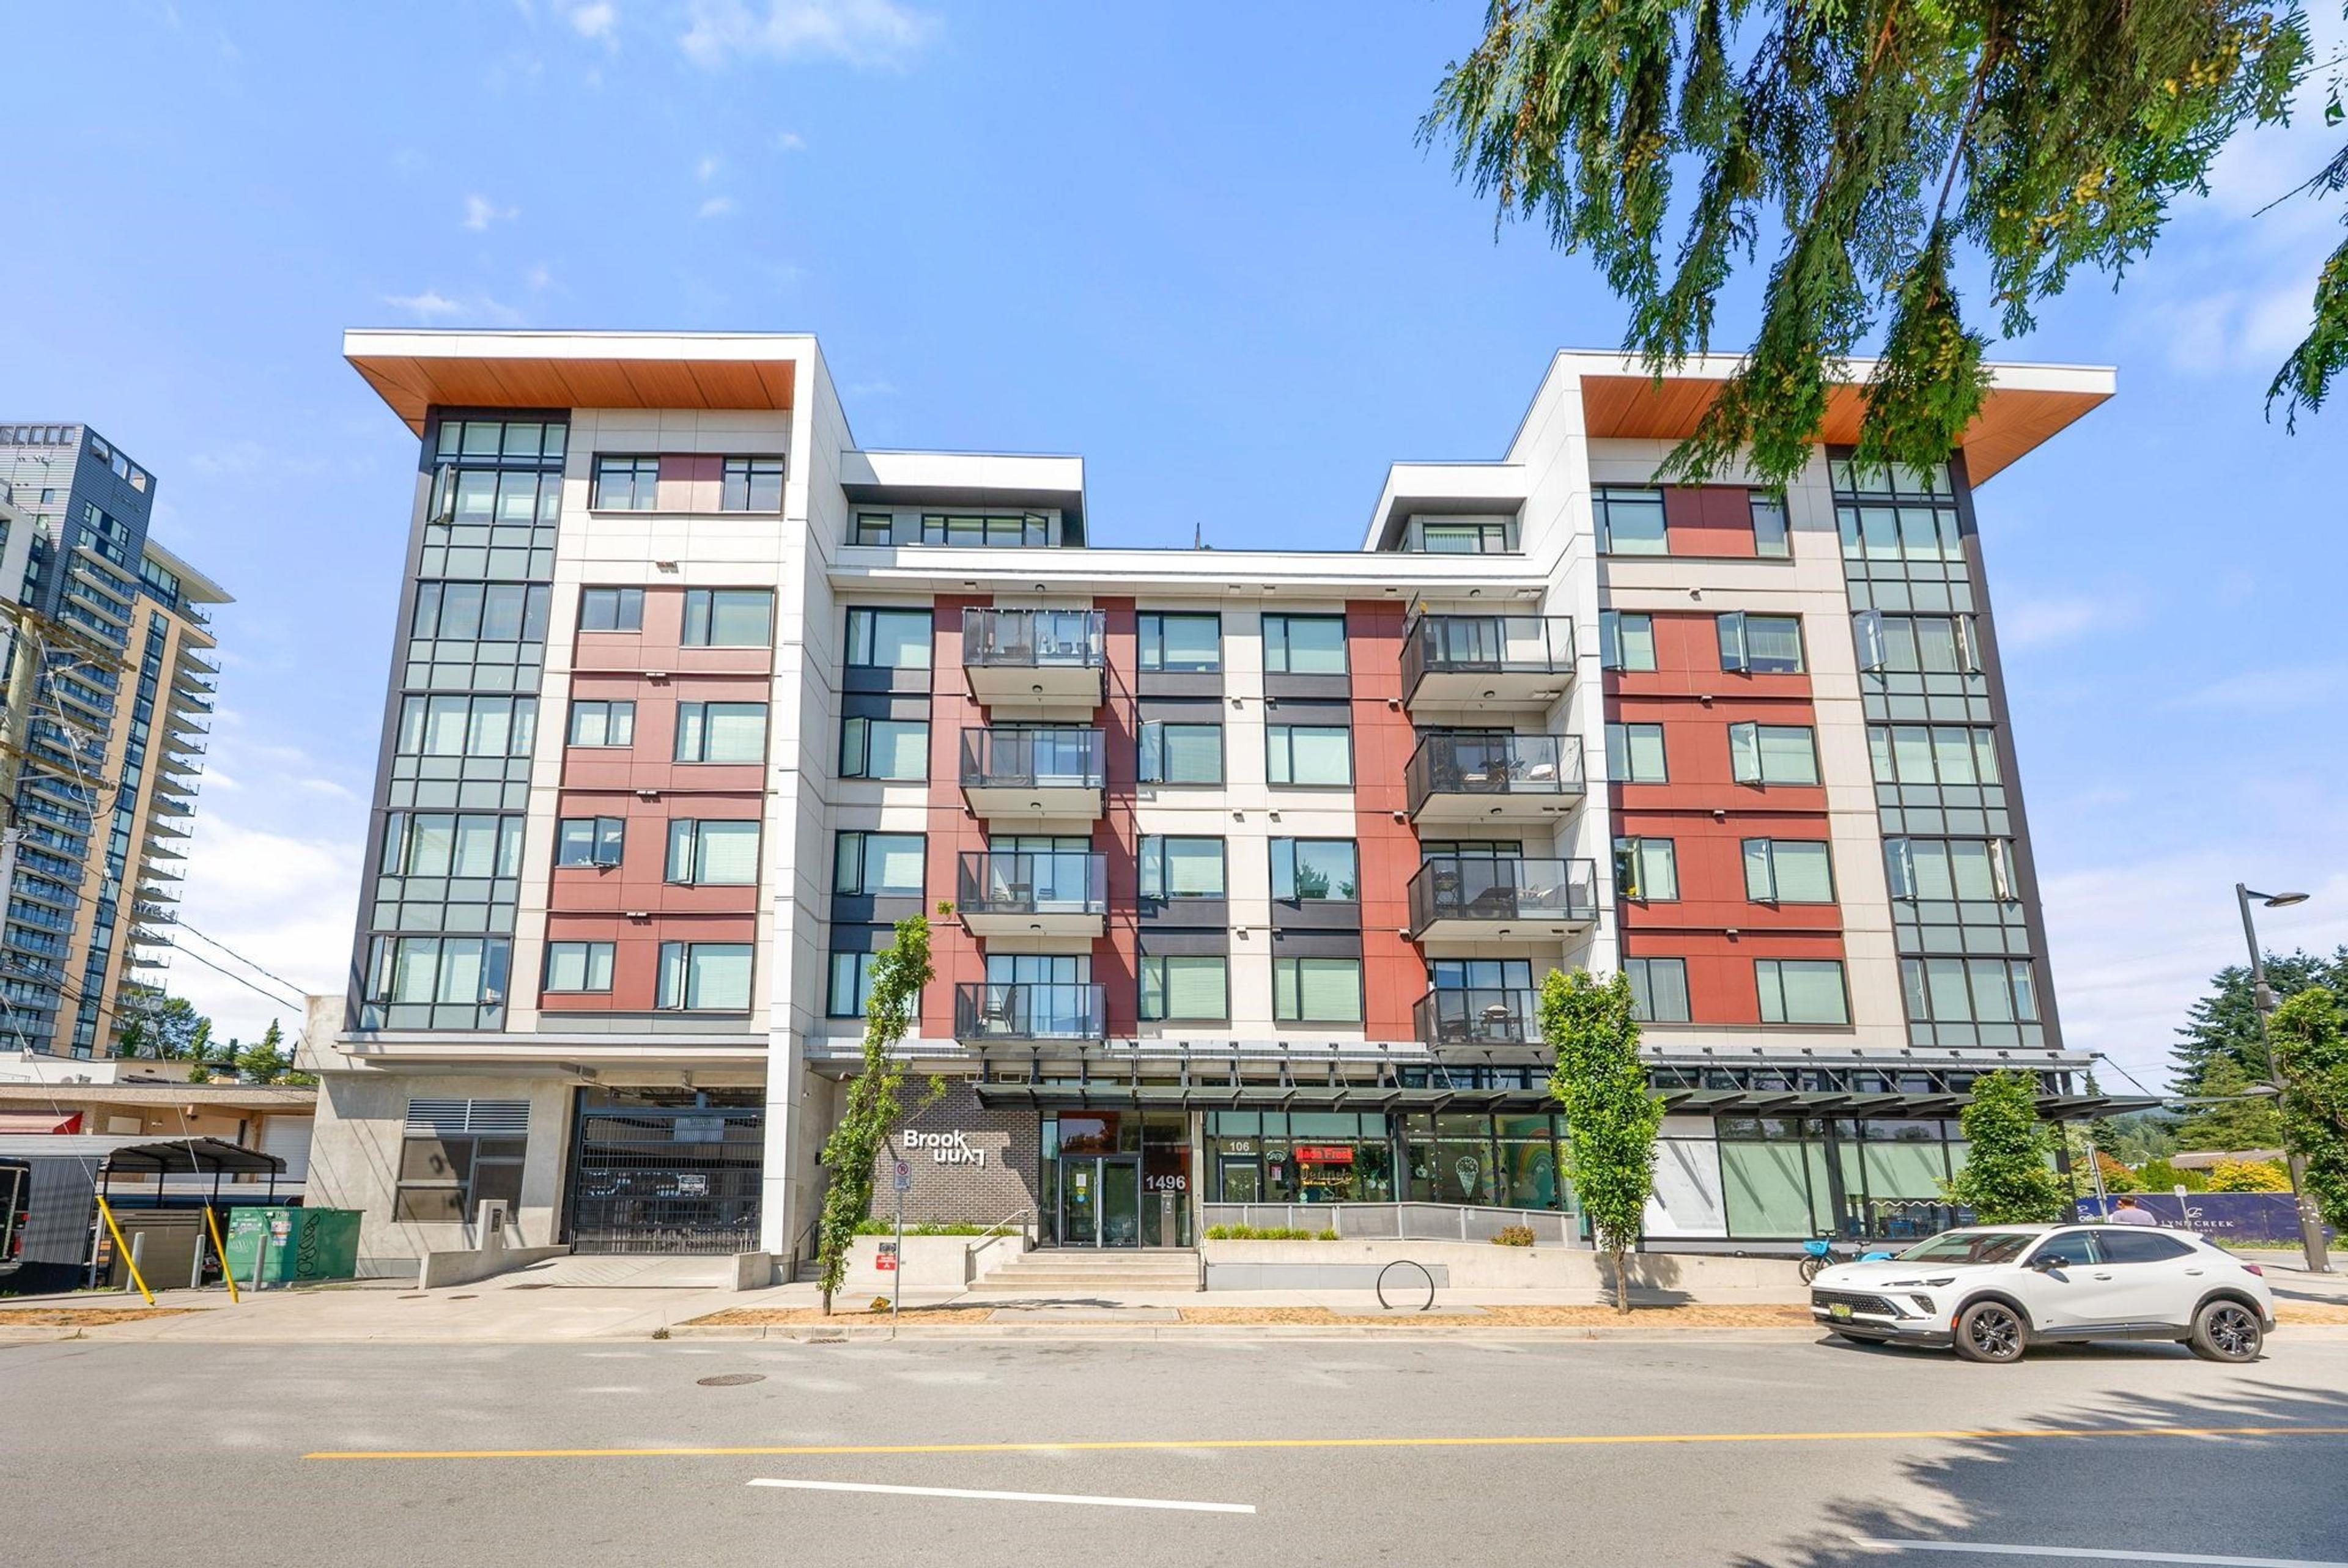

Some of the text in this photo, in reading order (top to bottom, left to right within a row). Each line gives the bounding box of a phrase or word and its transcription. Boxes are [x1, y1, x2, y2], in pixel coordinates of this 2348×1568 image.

[904, 1129, 966, 1147] Brook
[1230, 1141, 1250, 1152] 106
[1146, 1175, 1186, 1190] 1496
